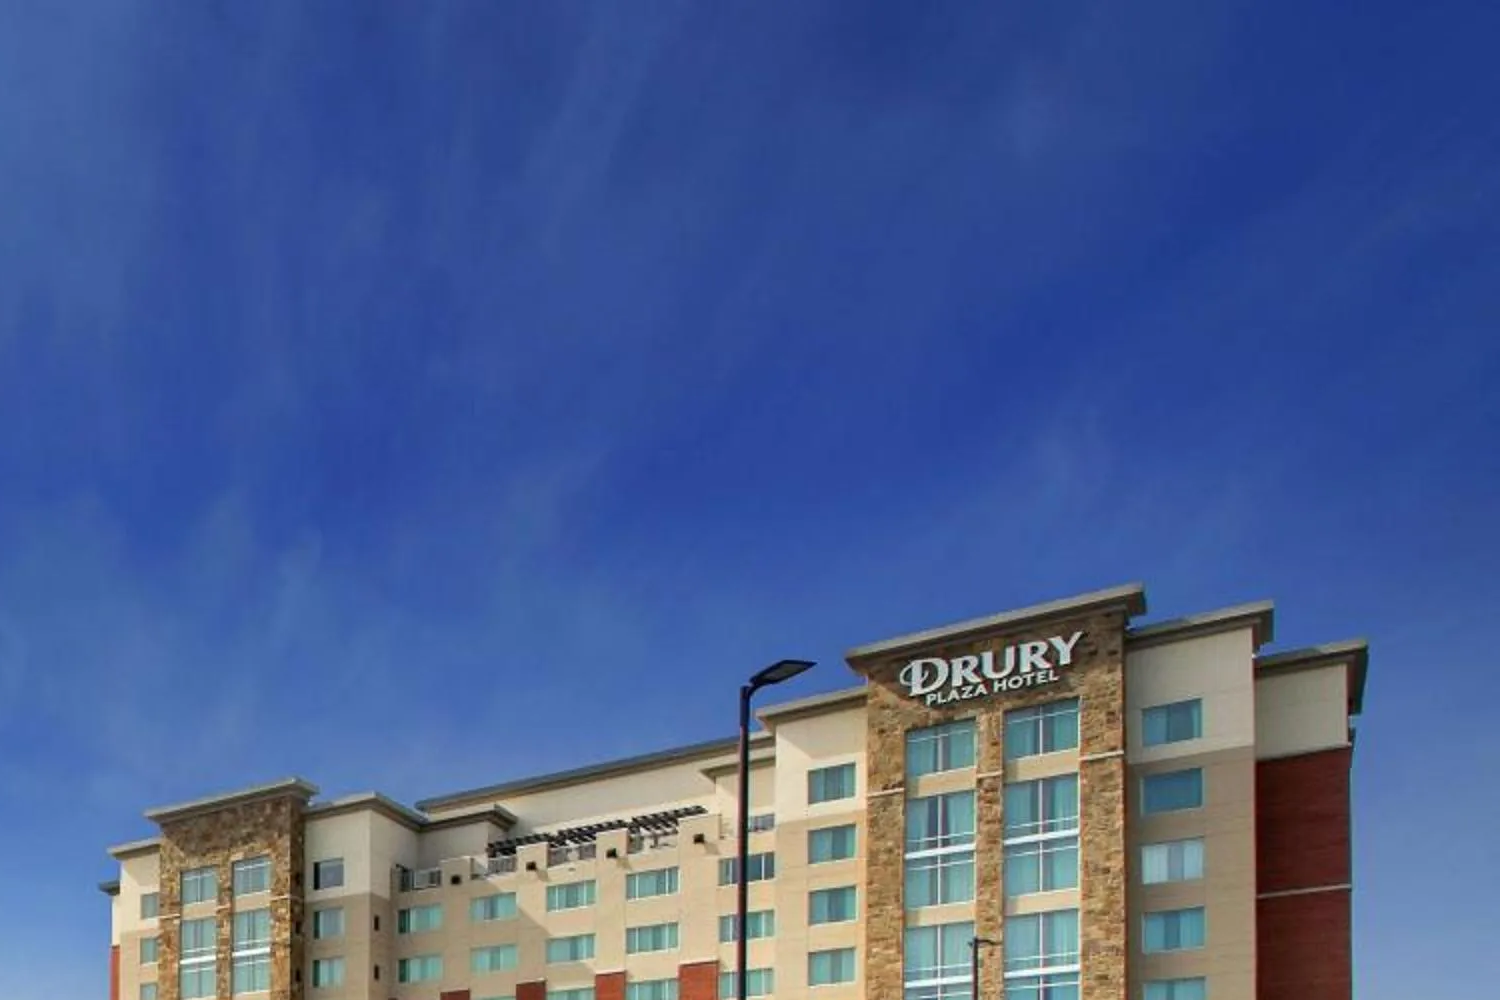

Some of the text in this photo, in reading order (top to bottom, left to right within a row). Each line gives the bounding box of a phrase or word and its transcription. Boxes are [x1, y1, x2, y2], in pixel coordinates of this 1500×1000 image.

[900, 631, 1083, 696] DRURY
[926, 669, 1060, 706] PLAZA HOTEL
